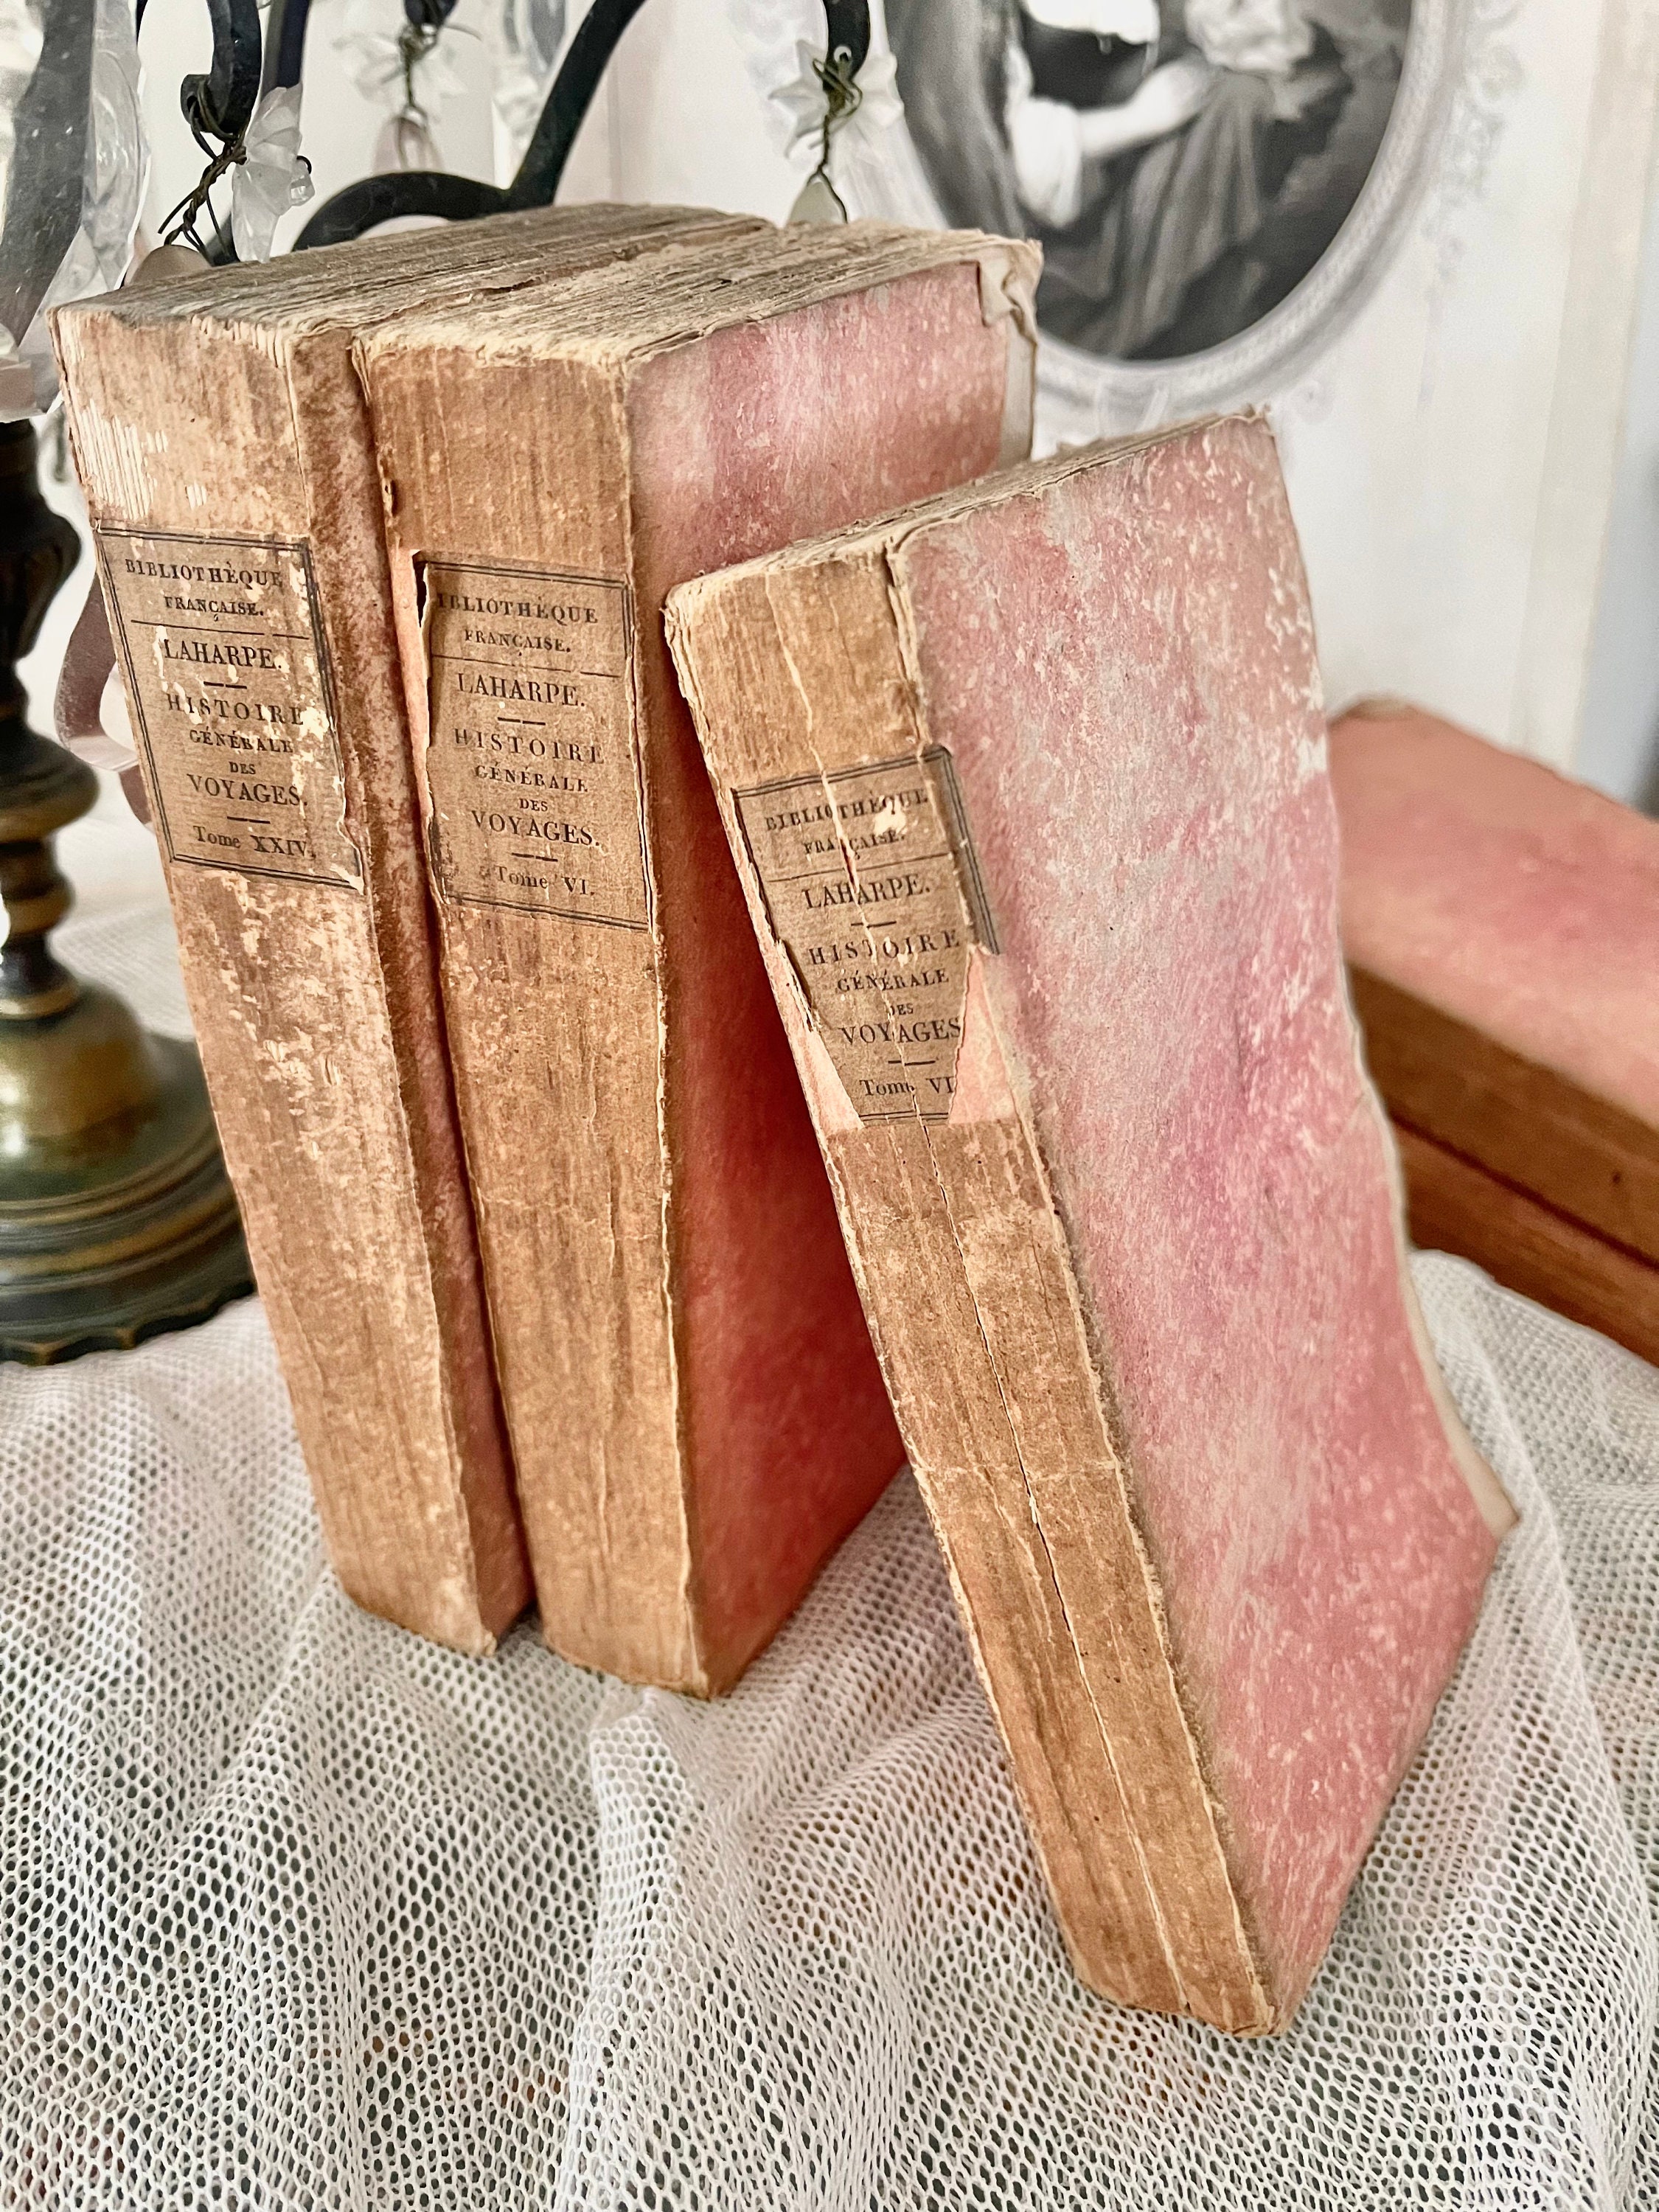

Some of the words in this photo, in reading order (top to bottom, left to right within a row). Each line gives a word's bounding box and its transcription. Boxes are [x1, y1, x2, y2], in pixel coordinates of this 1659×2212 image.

[125, 559, 283, 590] BIBLIOTHÈQUE
[164, 595, 264, 622] FRANÇAISE.
[437, 593, 599, 627] IBLIOTHÈQUE
[163, 639, 282, 669] LAHARPE.
[465, 628, 571, 656] FRANÇAISE.
[458, 673, 585, 708] LAHARPE.
[167, 694, 304, 726] HISTOIRE
[454, 728, 604, 765] HISTOIRE
[229, 762, 256, 775] DES
[475, 762, 588, 793] GÉNÉRALE
[187, 773, 307, 806] VOYAGES.
[519, 798, 549, 812] DES
[192, 825, 241, 849] Tome
[250, 835, 316, 858] XXIV.
[471, 810, 599, 846] VOYAGES.
[801, 830, 905, 860] FRAÇAISE.
[494, 864, 549, 889] Tome
[563, 876, 595, 897] VI.
[801, 873, 931, 910] LAHARPE.
[808, 929, 961, 965] HISTOIRE
[837, 967, 950, 992] GÉNÉRALE
